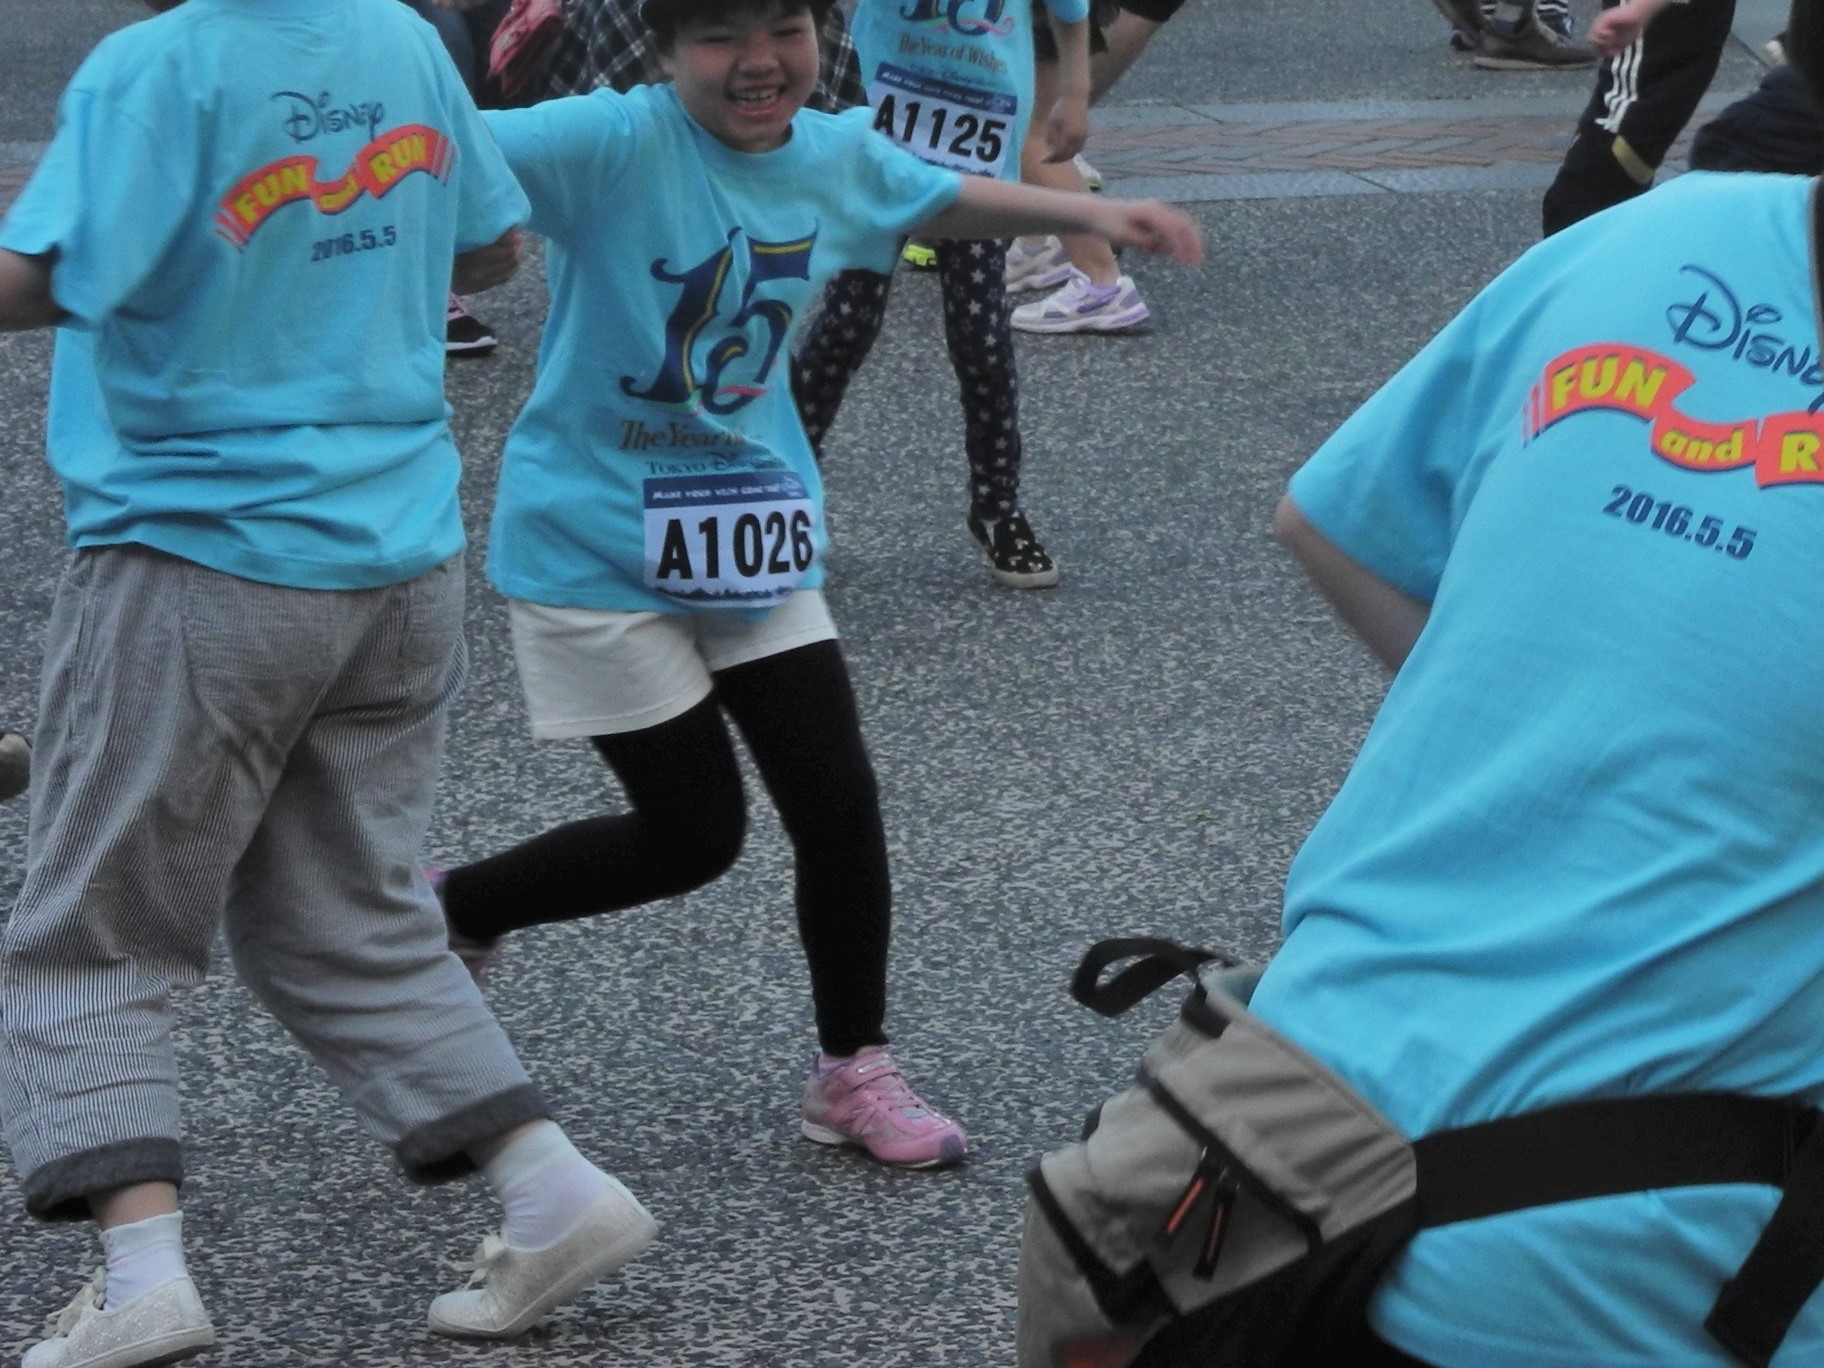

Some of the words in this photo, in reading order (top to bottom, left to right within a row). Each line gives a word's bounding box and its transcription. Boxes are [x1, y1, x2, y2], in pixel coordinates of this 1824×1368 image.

[270, 90, 386, 144] Disney
[873, 93, 1007, 164] A1125
[231, 162, 309, 225] FUN
[368, 132, 428, 185] RUN
[619, 216, 820, 416] 15
[1552, 355, 1669, 422] FUN
[1660, 428, 1745, 465] and
[655, 508, 814, 580] A1026
[1601, 484, 1759, 562] 2016.5.5
